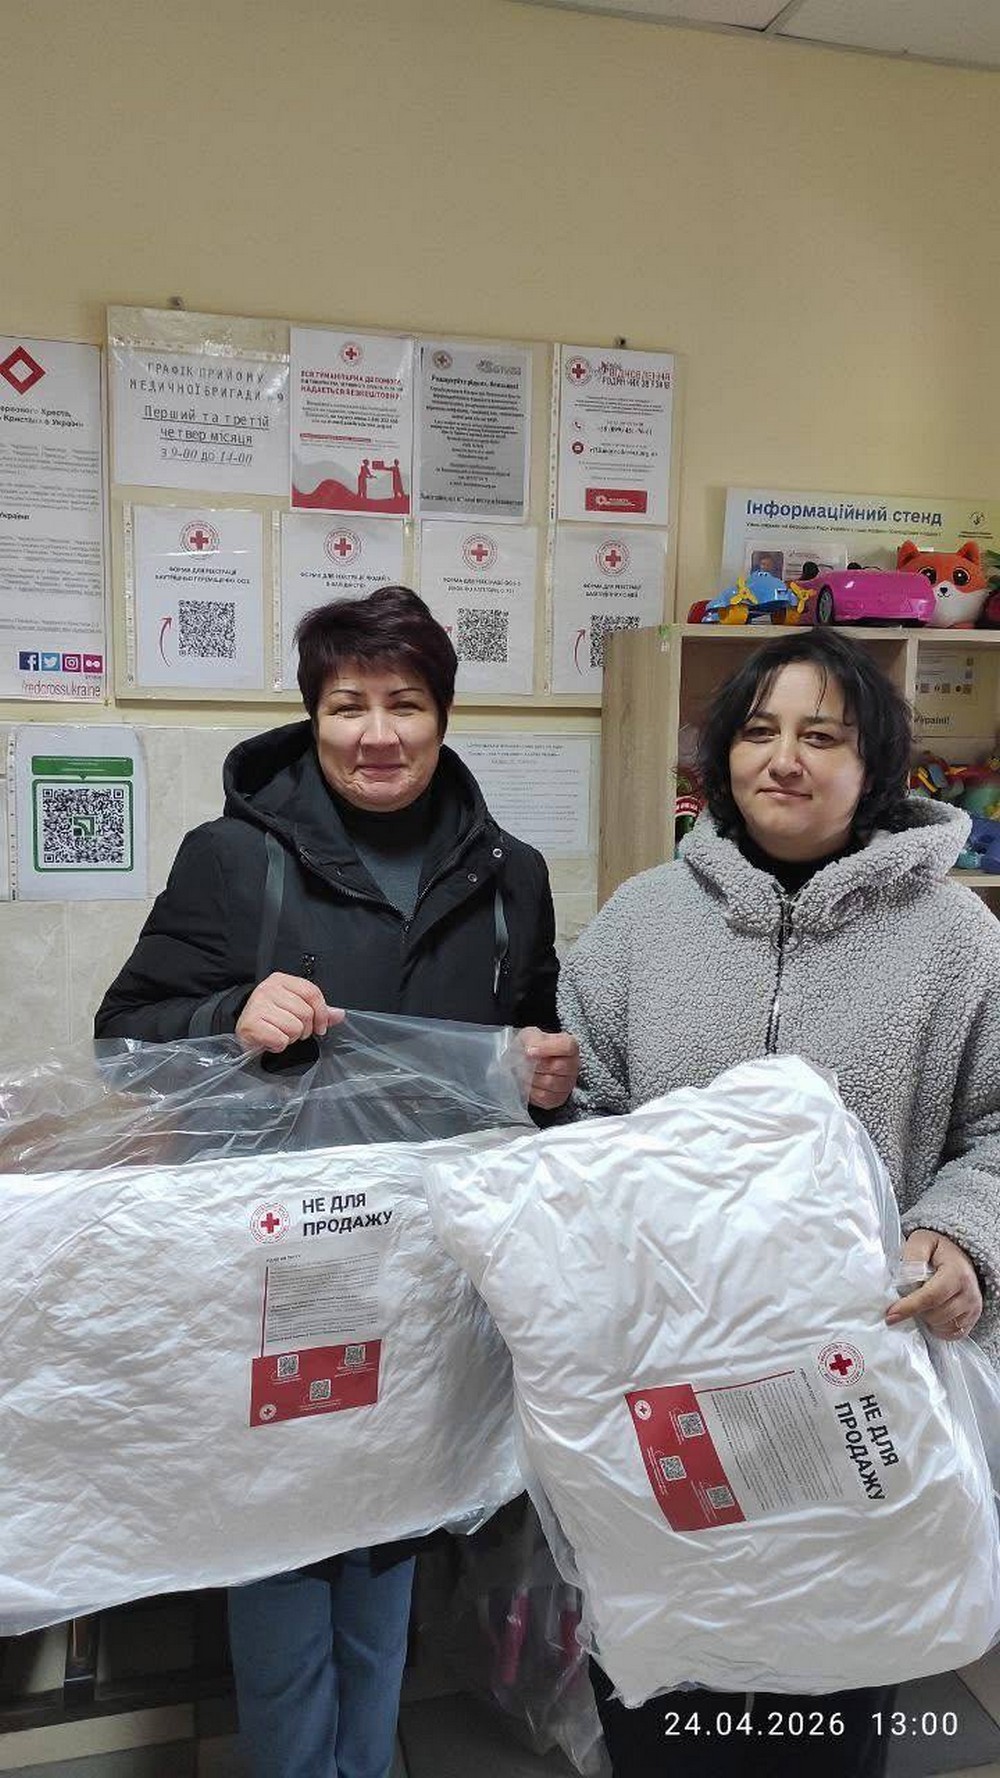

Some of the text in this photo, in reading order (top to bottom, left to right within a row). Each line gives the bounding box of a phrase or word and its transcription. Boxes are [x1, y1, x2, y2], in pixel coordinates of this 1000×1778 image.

[147, 362, 264, 384] ГРАФІК ПРИЙОМУ
[129, 378, 200, 396] МЕДИЧНОЇ
[204, 385, 261, 401] БРИГАДИ
[144, 404, 269, 429] Перший та третій
[160, 427, 253, 446] четвер місяця
[170, 447, 198, 459] 9-00
[201, 452, 216, 463] до
[746, 499, 943, 527] Інформаційний стенд
[302, 1193, 366, 1214] НЕ ДЛЯ
[303, 1210, 393, 1237] ПРОДАЖУ
[860, 1394, 899, 1467] НЕ ДЛЯ
[834, 1401, 886, 1500] ПРОДАЖУ
